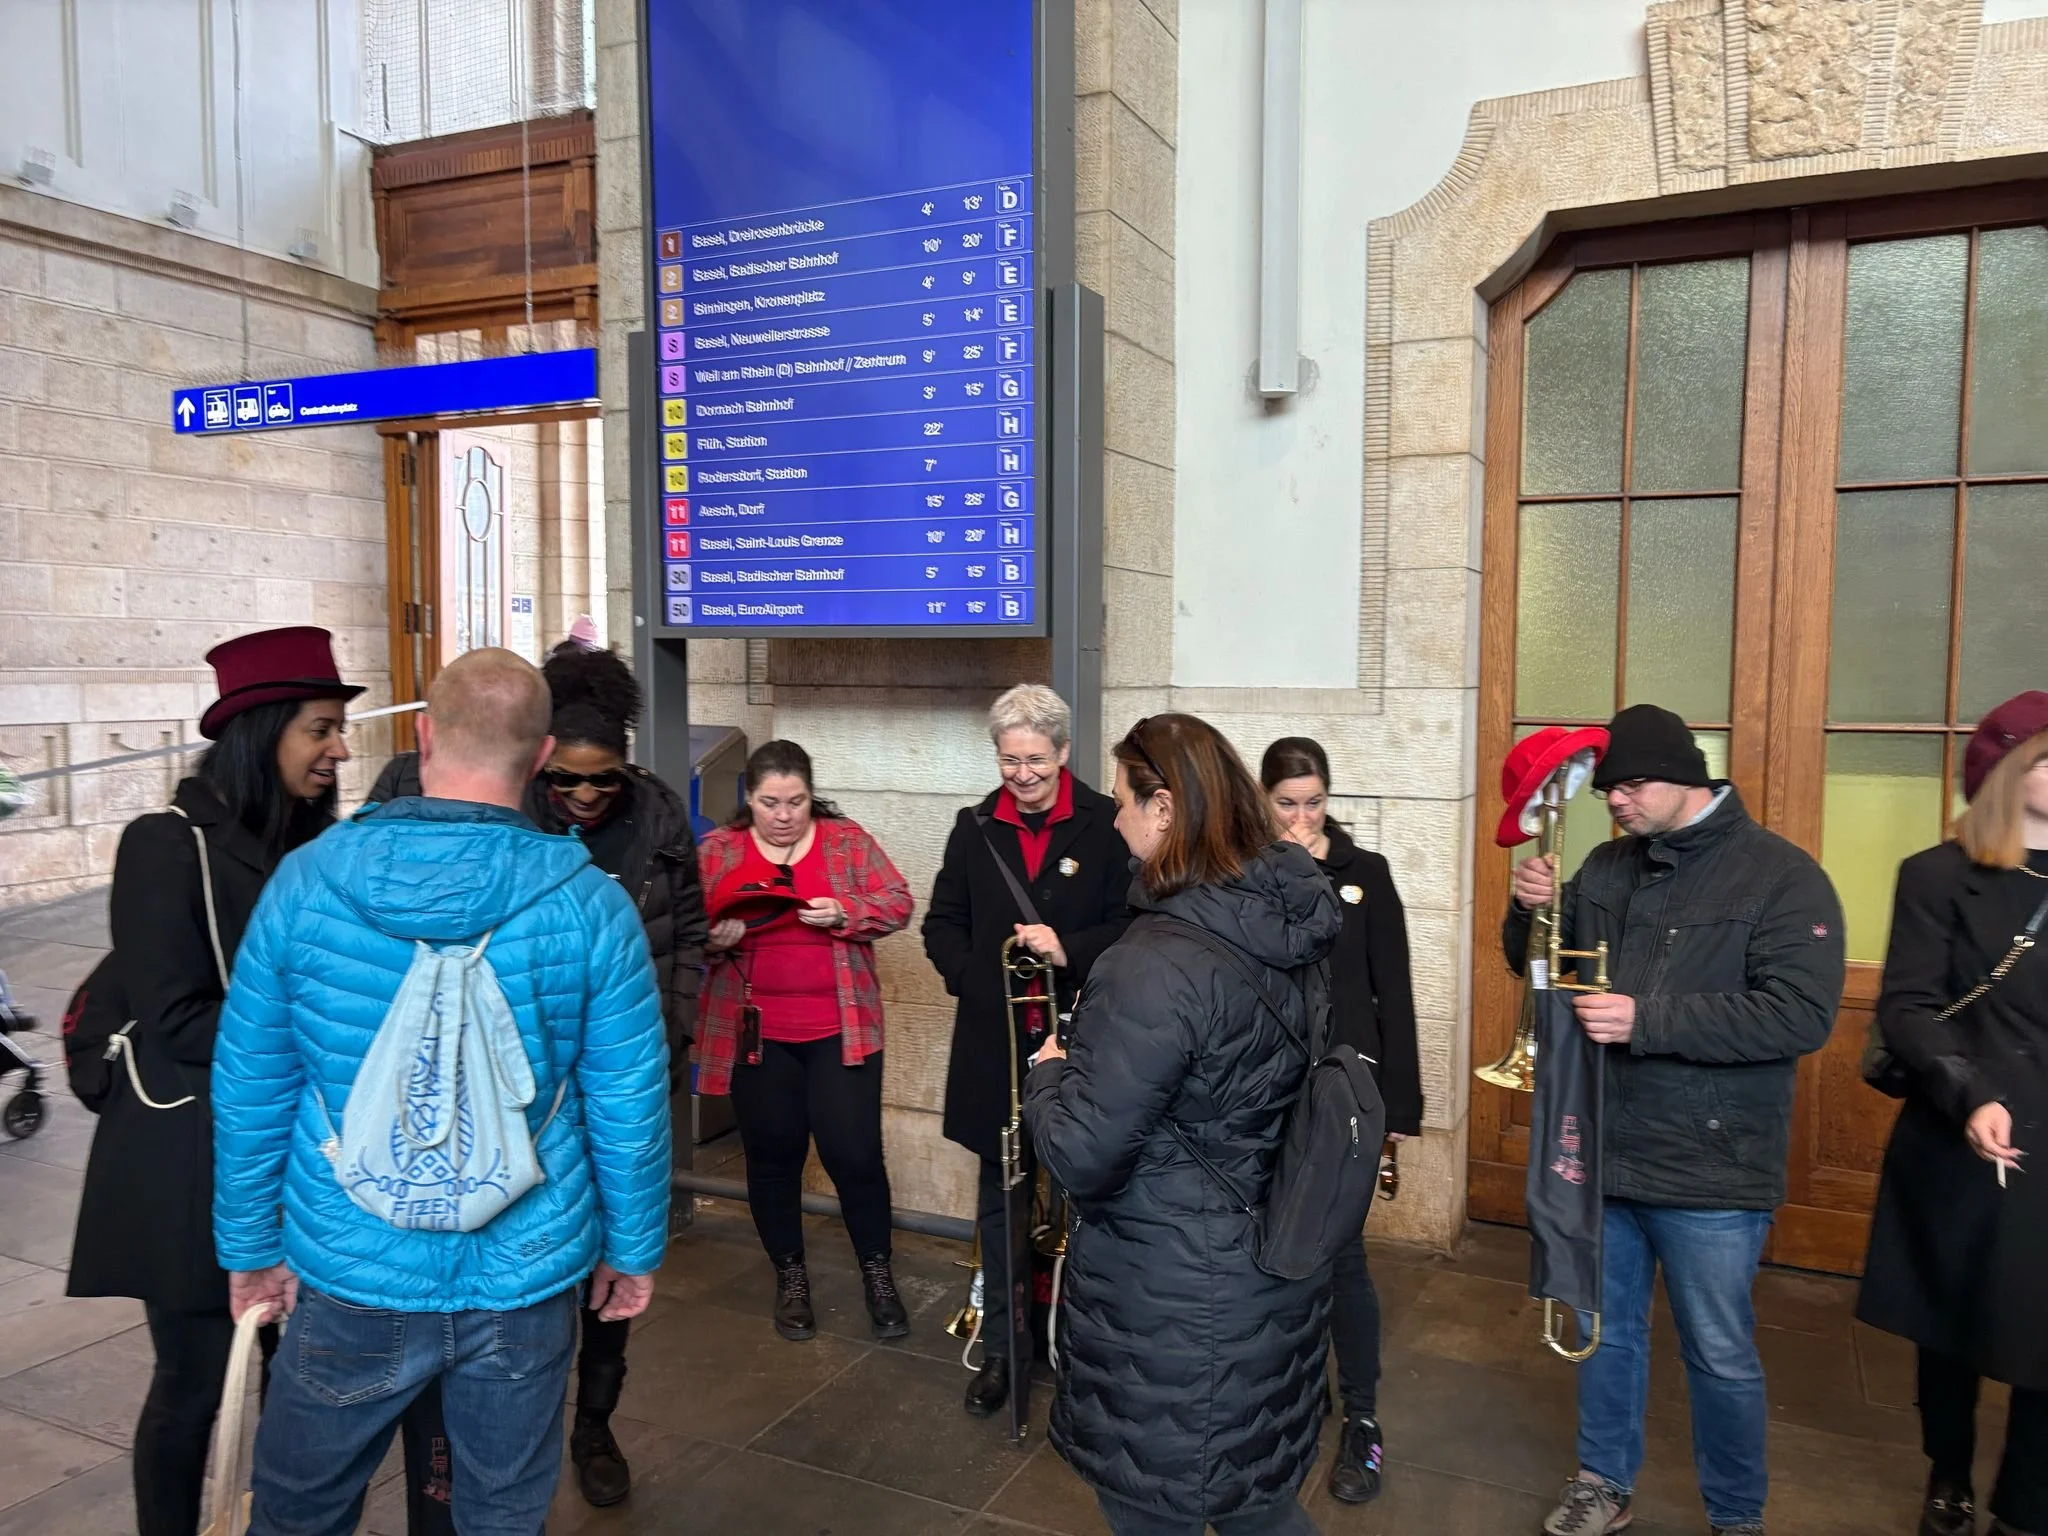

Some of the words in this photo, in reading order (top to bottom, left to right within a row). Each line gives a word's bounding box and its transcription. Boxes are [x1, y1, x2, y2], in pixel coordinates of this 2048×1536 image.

[692, 232, 728, 248] Basel,
[729, 219, 825, 243] Dreirosenbrücke
[1003, 192, 1018, 208] D
[666, 270, 677, 286] 2
[693, 266, 728, 282] Basel,
[730, 260, 788, 278] Badischer
[788, 251, 840, 270] Bahnhof
[1004, 229, 1017, 246] F
[667, 304, 678, 320] 2
[694, 298, 754, 317] Binningen,
[754, 290, 826, 310] Kronenplatz
[1004, 266, 1018, 284] E
[694, 335, 730, 350] Basel,
[731, 326, 830, 346] Neuweilerstrasse
[1004, 304, 1018, 322] E
[695, 369, 720, 384] Weil
[721, 370, 740, 381] am
[741, 366, 774, 379] Rhein
[776, 363, 793, 379] (D)
[794, 358, 845, 374] Bahnhof
[846, 357, 852, 372] /
[854, 354, 907, 368] Zentrum
[1004, 342, 1018, 360] F
[696, 402, 745, 417] Dornach
[745, 398, 795, 414] Bahnhof
[1002, 379, 1019, 397] G
[726, 434, 768, 449] Station
[1004, 417, 1018, 434] H
[698, 470, 764, 484] Rodersdorf,
[765, 466, 808, 480] Station
[1004, 454, 1019, 471] H
[669, 504, 686, 520] 11
[699, 505, 738, 518] Aesch,
[738, 503, 766, 516] Dorf
[1004, 491, 1020, 508] G
[670, 538, 688, 553] 11
[700, 538, 735, 551] Basel,
[736, 536, 800, 550] Saint-Louis
[801, 534, 844, 548] Grenze
[1004, 528, 1020, 544] H
[701, 571, 736, 585] Basel,
[737, 570, 794, 584] Badischer
[794, 568, 845, 582] Bahnhof
[1005, 564, 1020, 581] B
[702, 604, 737, 618] Basel,
[738, 604, 804, 618] EuroAirport
[1005, 600, 1020, 617] B
